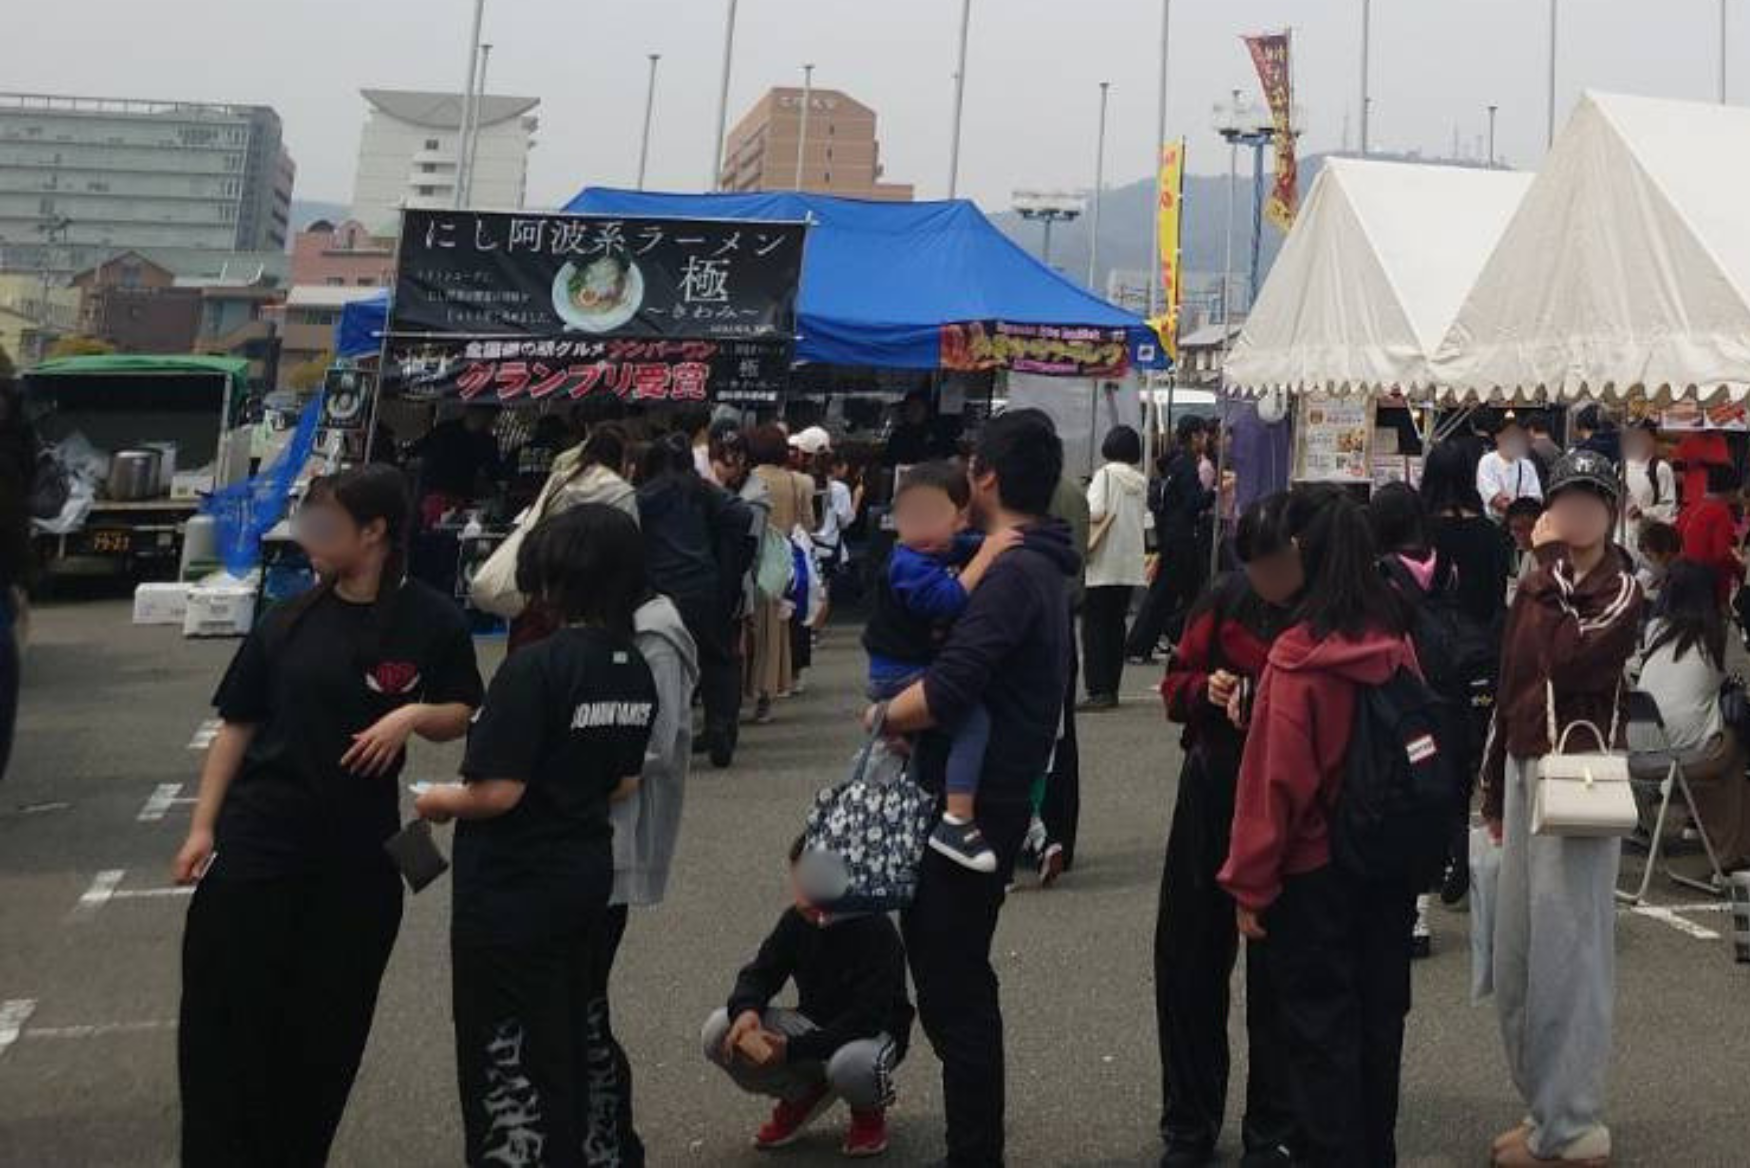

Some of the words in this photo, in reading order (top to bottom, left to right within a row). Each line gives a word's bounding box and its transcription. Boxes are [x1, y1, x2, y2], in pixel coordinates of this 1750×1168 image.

[425, 218, 786, 256] にし阿波系ラーメン
[678, 255, 732, 303] 極
[456, 361, 711, 401] グランプリ受賞
